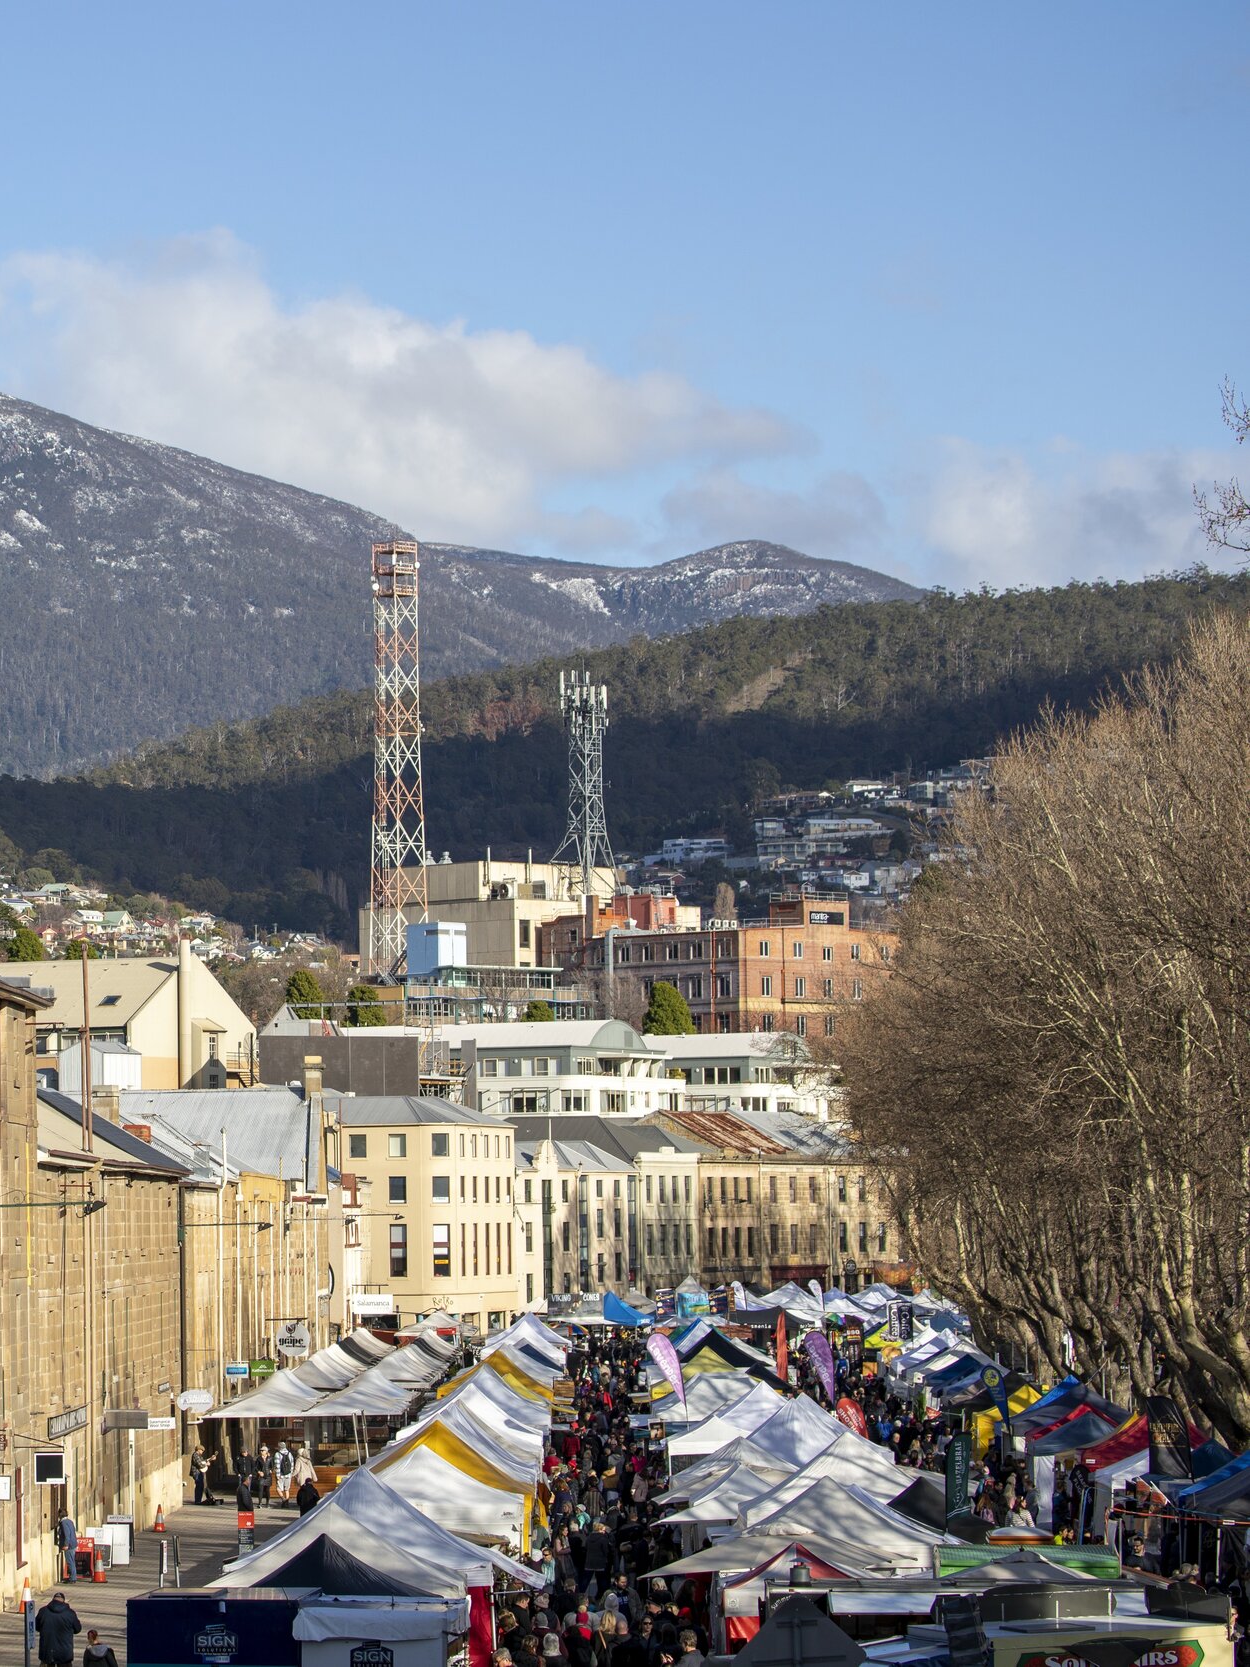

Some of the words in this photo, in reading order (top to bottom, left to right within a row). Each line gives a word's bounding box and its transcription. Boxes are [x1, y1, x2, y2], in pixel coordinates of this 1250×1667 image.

[551, 1294, 571, 1302] VIKING
[582, 1293, 600, 1301] CONES
[890, 1308, 898, 1336] Coffee
[900, 1311, 910, 1339] Coffee
[278, 1337, 304, 1348] grape
[953, 1441, 962, 1484] HAZELBRAE
[197, 1635, 236, 1647] SIGN
[353, 1651, 392, 1662] SIGN
